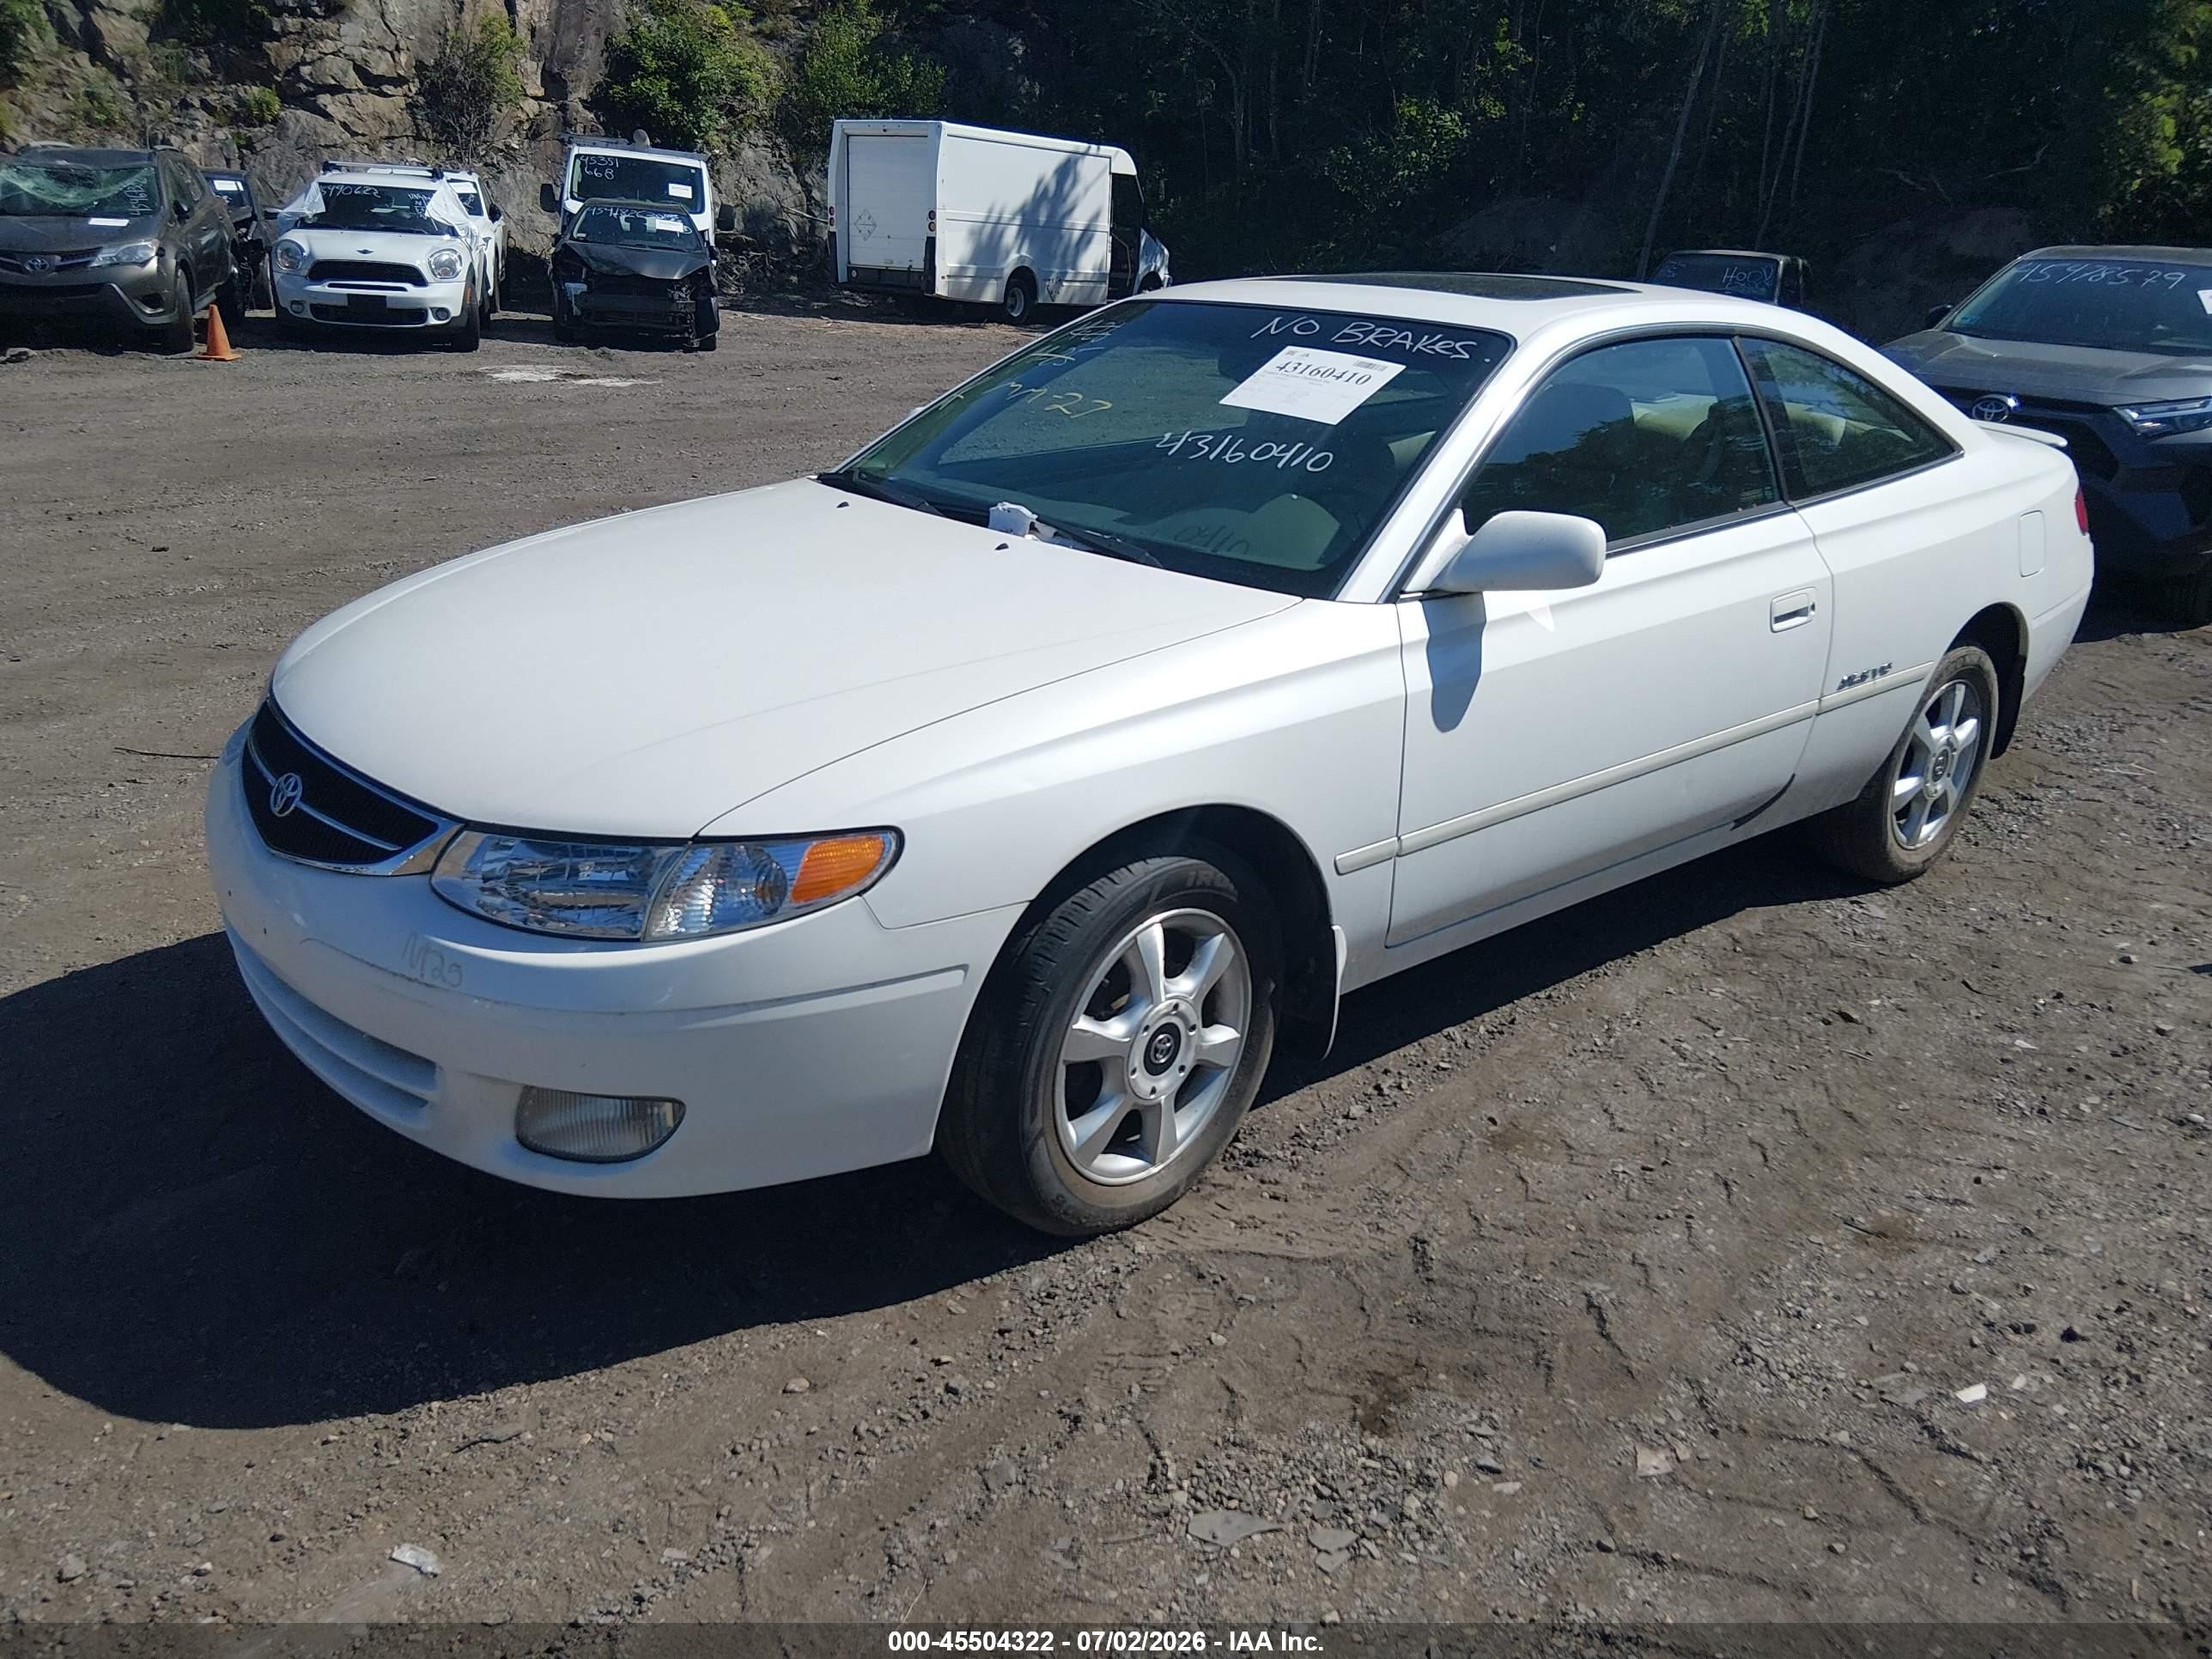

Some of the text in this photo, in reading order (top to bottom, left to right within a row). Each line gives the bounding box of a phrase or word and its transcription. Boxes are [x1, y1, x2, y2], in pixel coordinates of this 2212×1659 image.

[580, 155, 618, 168] 45351
[585, 167, 615, 180] 668
[1250, 315, 1321, 339] NO
[1274, 360, 1372, 386] 43160410
[1155, 430, 1334, 472] 43160410
